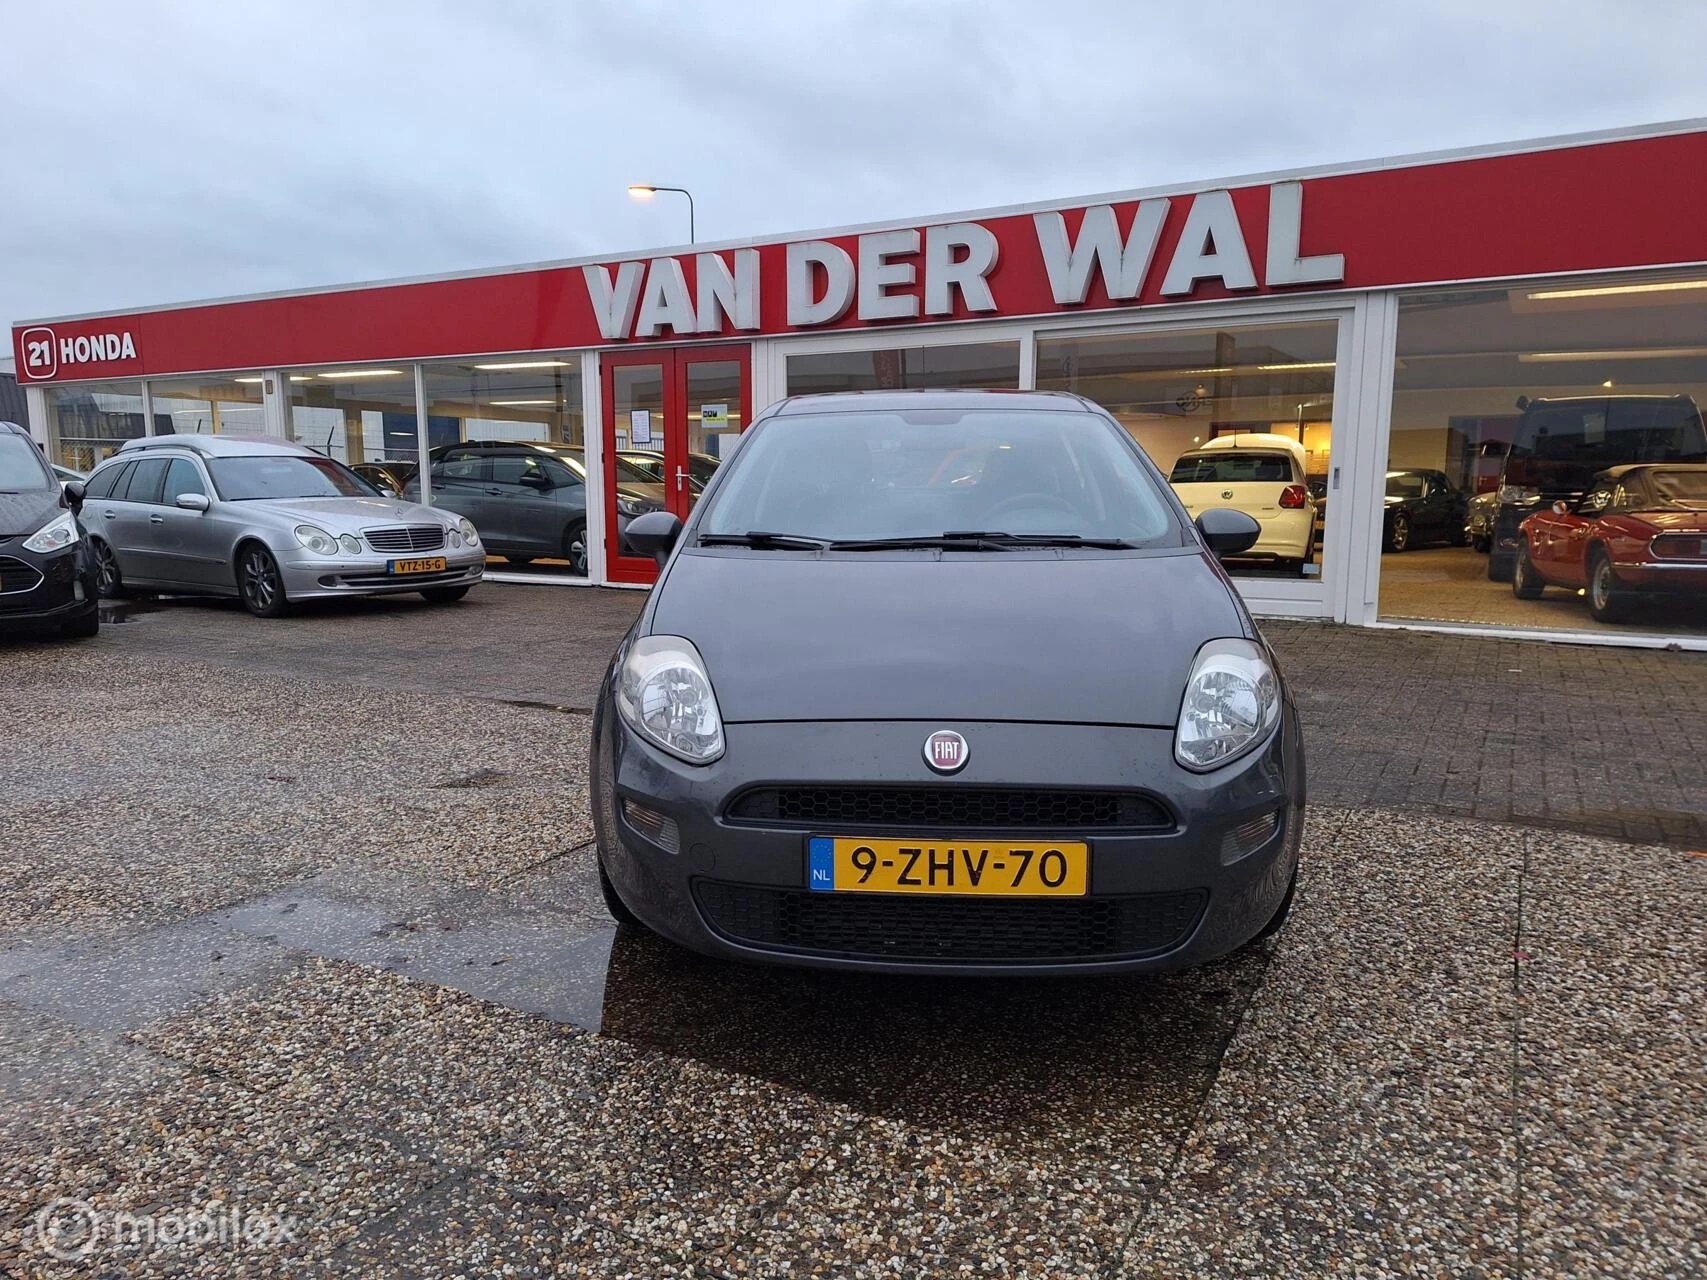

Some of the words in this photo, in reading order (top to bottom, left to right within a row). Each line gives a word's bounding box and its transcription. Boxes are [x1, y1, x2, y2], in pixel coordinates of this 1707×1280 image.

[583, 248, 760, 340] VAN
[786, 222, 999, 327] DER
[1033, 180, 1346, 304] WAL
[28, 340, 51, 367] 21
[60, 332, 137, 364] HONDA
[400, 560, 441, 572] VTZ-15-G
[935, 741, 960, 759] FIAT
[813, 868, 830, 882] NL
[851, 846, 1067, 886] 9-ZHV-70
